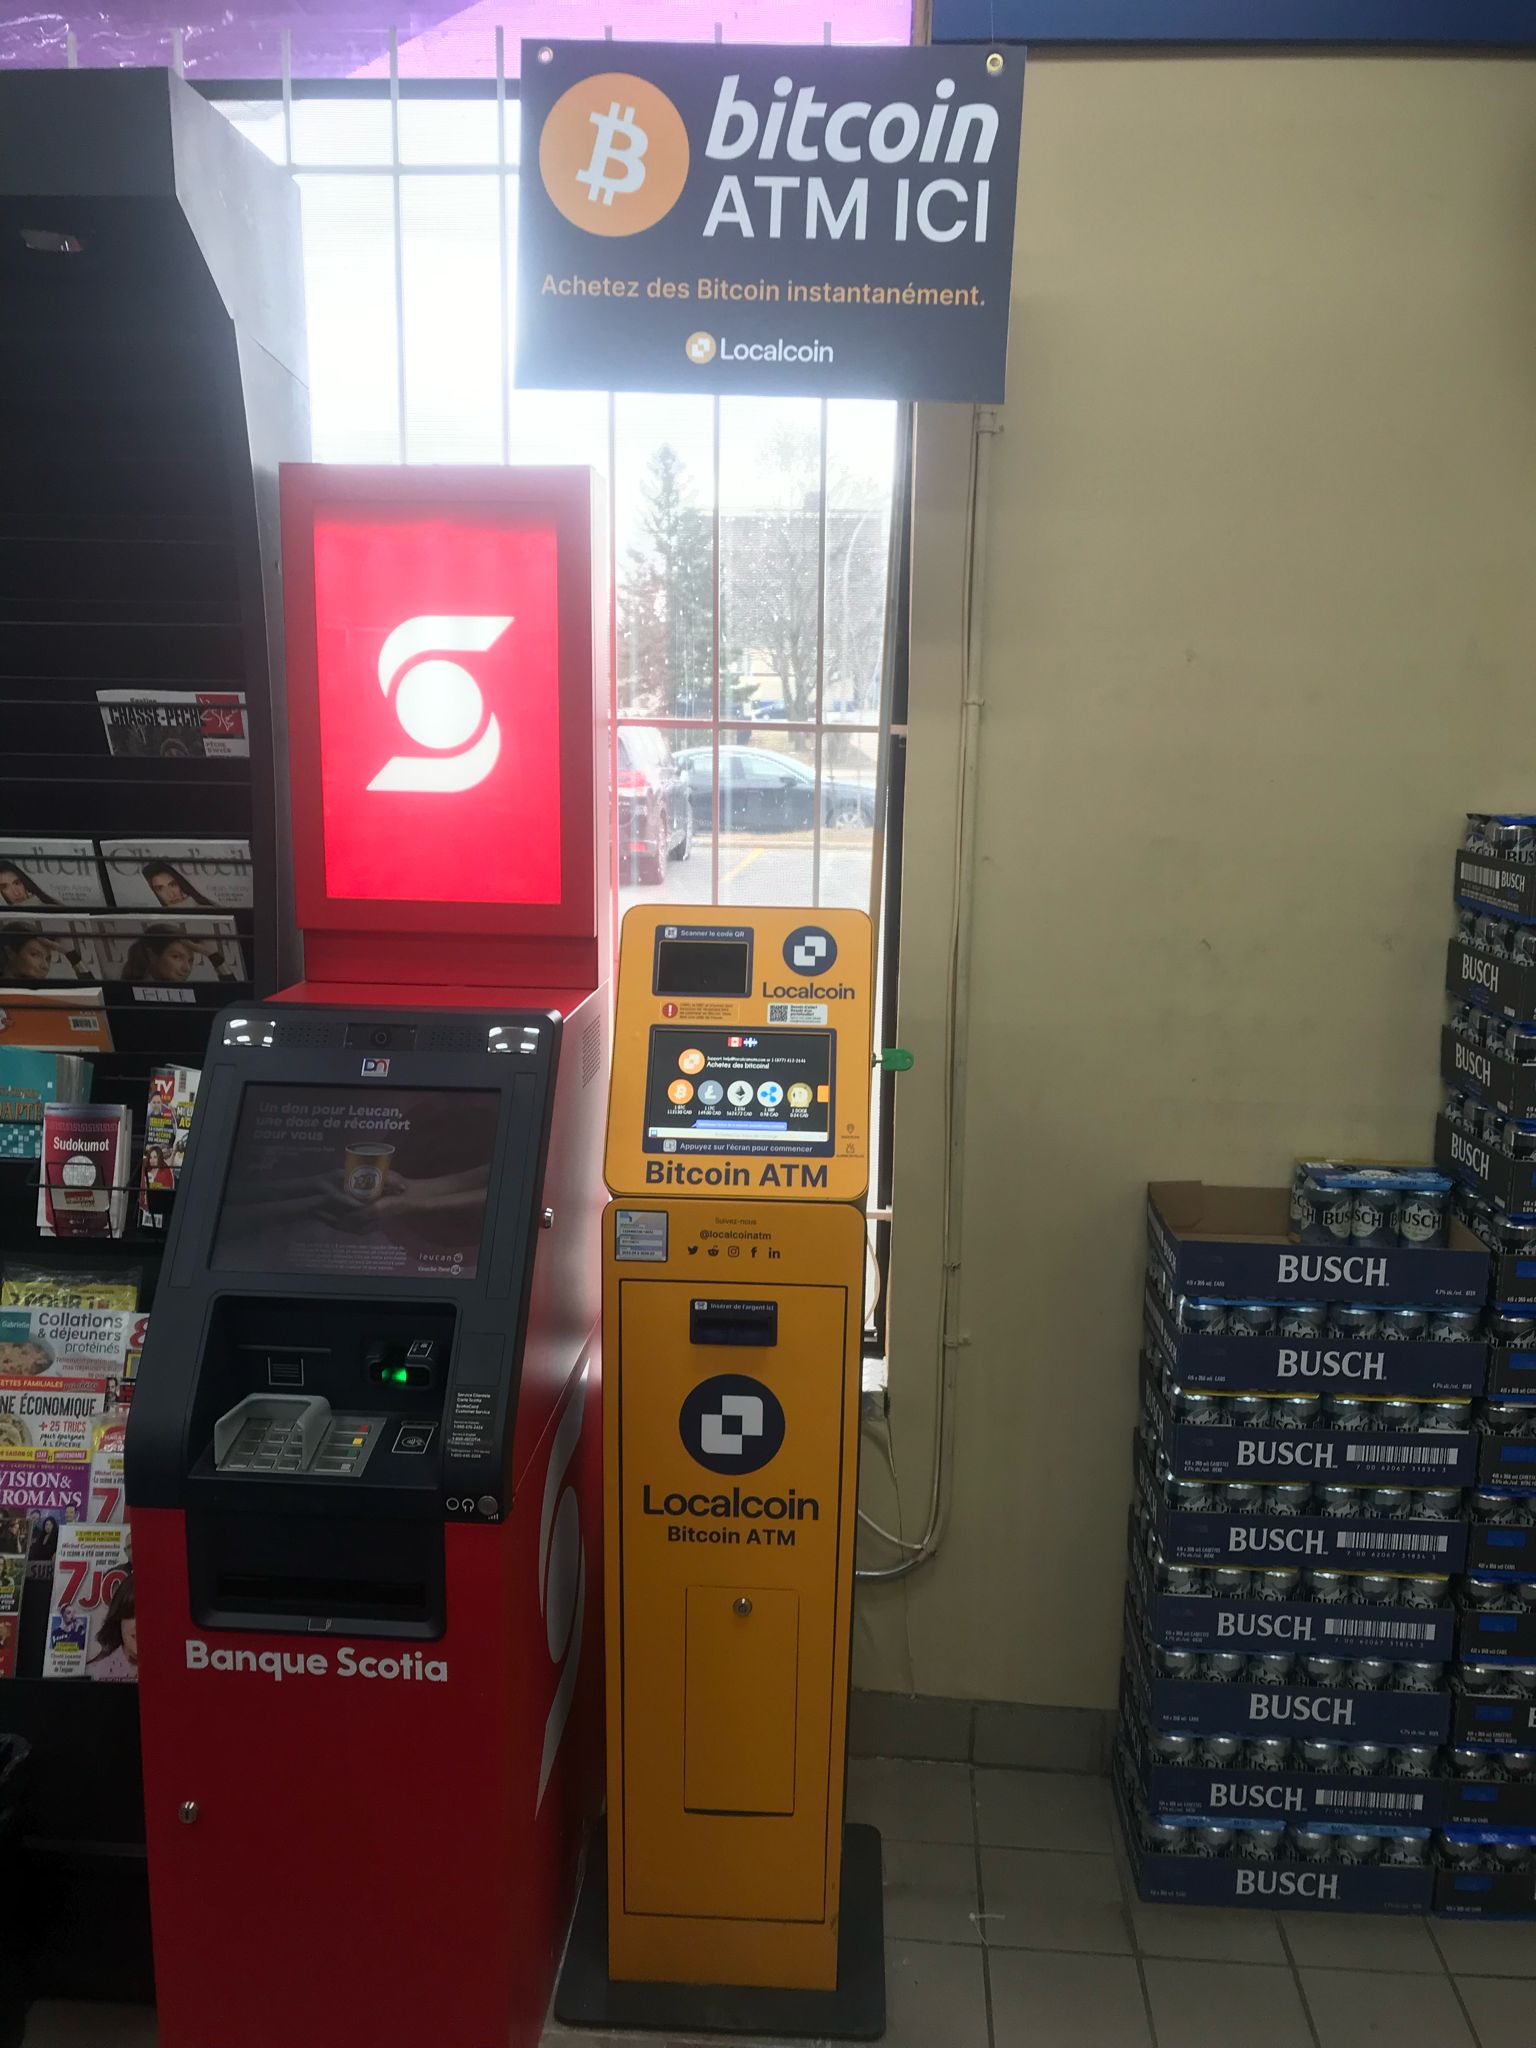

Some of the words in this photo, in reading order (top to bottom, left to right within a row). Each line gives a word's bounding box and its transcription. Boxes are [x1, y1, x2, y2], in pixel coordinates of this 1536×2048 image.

[705, 74, 999, 164] bitcoin
[702, 175, 868, 240] ATM
[895, 178, 989, 242] ICI
[541, 274, 639, 299] Achetez
[646, 278, 690, 300] des
[697, 279, 779, 302] Bitcoin
[787, 281, 986, 306] instantanément.
[720, 337, 834, 363] Localcoin
[1501, 870, 1525, 893] BUSCH
[680, 929, 708, 937] Scanner
[709, 929, 716, 937] le
[716, 930, 733, 938] code
[734, 930, 745, 938] QR
[1461, 953, 1499, 993] BUSCH
[762, 981, 855, 999] Localcoin
[1455, 1042, 1492, 1087] BUSCH
[259, 1101, 279, 1113] Un
[281, 1103, 310, 1115] don
[312, 1105, 345, 1117] pour
[347, 1105, 403, 1119] Leucan,
[286, 1115, 320, 1129] dose
[323, 1116, 341, 1130] de
[344, 1117, 411, 1132] réconfort
[290, 1131, 324, 1142] vous
[53, 1136, 110, 1152] Sudokumot
[680, 1143, 712, 1152] Appuyez
[714, 1144, 726, 1152] sur
[726, 1143, 751, 1153] l'écran
[752, 1145, 769, 1154] pour
[770, 1145, 813, 1153] commencer
[1451, 1132, 1490, 1181] BUSCH
[645, 1160, 750, 1187] Bitcoin
[759, 1162, 828, 1188] ATM
[699, 1230, 771, 1241] @localcoinatm
[1277, 1254, 1389, 1288] BUSCH
[38, 1312, 123, 1330] Collations
[37, 1328, 46, 1339] &
[49, 1326, 122, 1343] déjeuners
[65, 1340, 120, 1354] protéinés
[1277, 1349, 1387, 1381] BUSCH
[23, 1380, 64, 1389] FAMILIALES
[19, 1393, 97, 1419] ÉCONOMIQUE
[49, 1420, 61, 1432] 25
[63, 1421, 87, 1433] TRUCS
[1236, 1440, 1336, 1469] BUSCH
[1, 1489, 82, 1508] ROMANS
[643, 1485, 819, 1521] Localcoin
[667, 1525, 740, 1545] Bitcoin
[746, 1528, 796, 1546] ATM
[1228, 1526, 1328, 1555] BUSCH
[1217, 1612, 1316, 1641] BUSCH
[185, 1639, 328, 1681] Banque
[336, 1647, 448, 1682] Scotia
[1249, 1693, 1354, 1726] BUSCH
[1209, 1783, 1307, 1812] BUSCH
[1235, 1869, 1339, 1900] BUSCH
